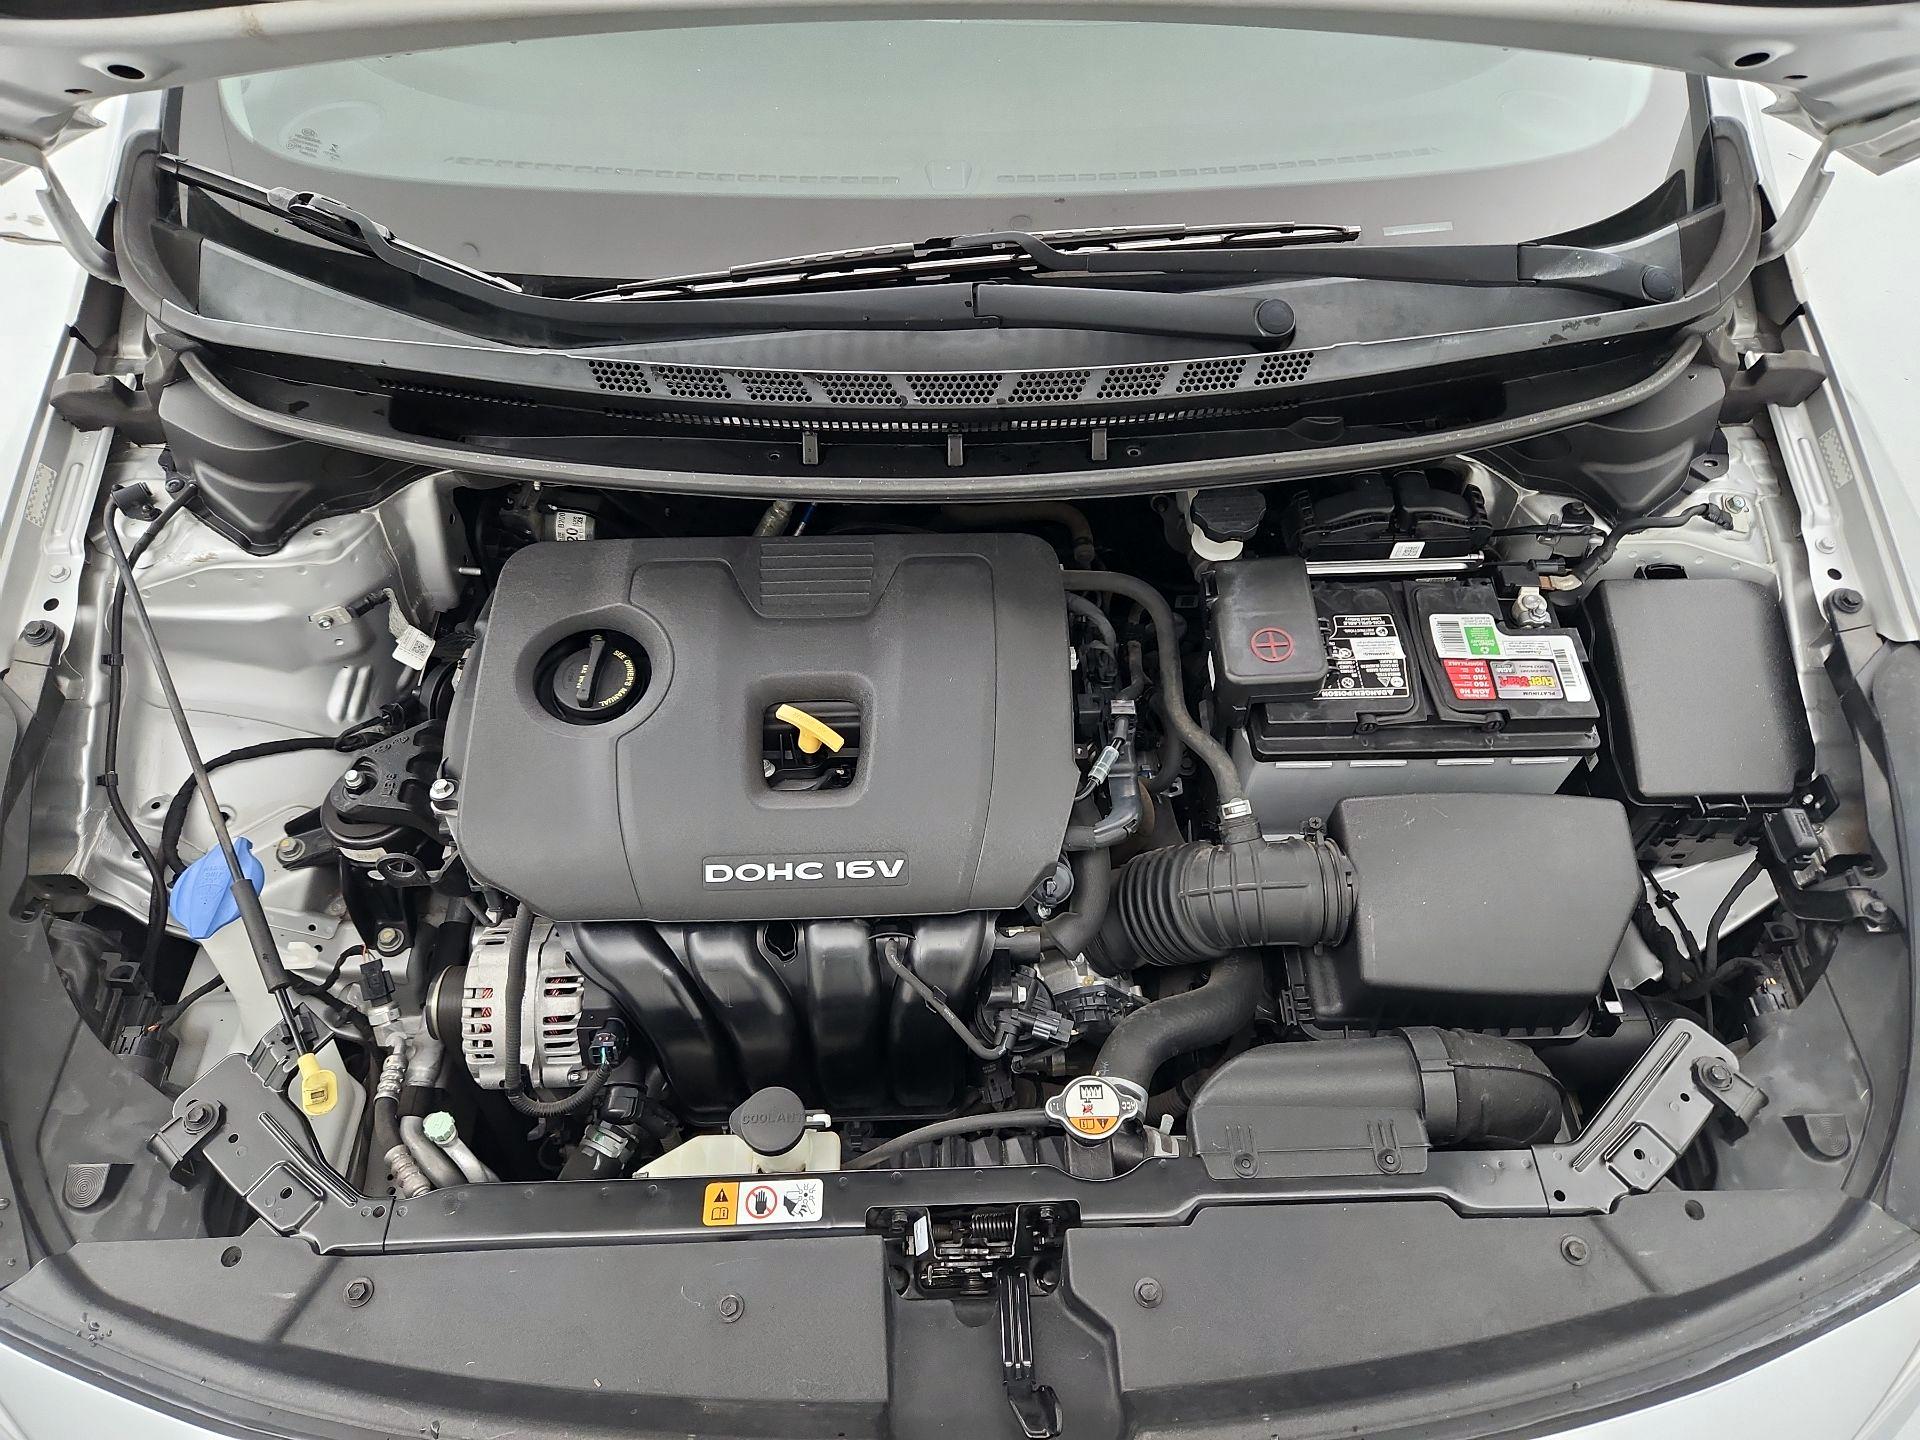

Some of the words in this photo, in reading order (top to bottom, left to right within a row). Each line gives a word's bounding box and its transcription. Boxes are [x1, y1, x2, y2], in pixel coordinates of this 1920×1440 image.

[612, 650, 627, 660] SEE
[598, 687, 628, 707] MANUAL
[704, 861, 825, 883] DOHC
[834, 859, 905, 880] 16V
[742, 1112, 804, 1125] COOLANT
